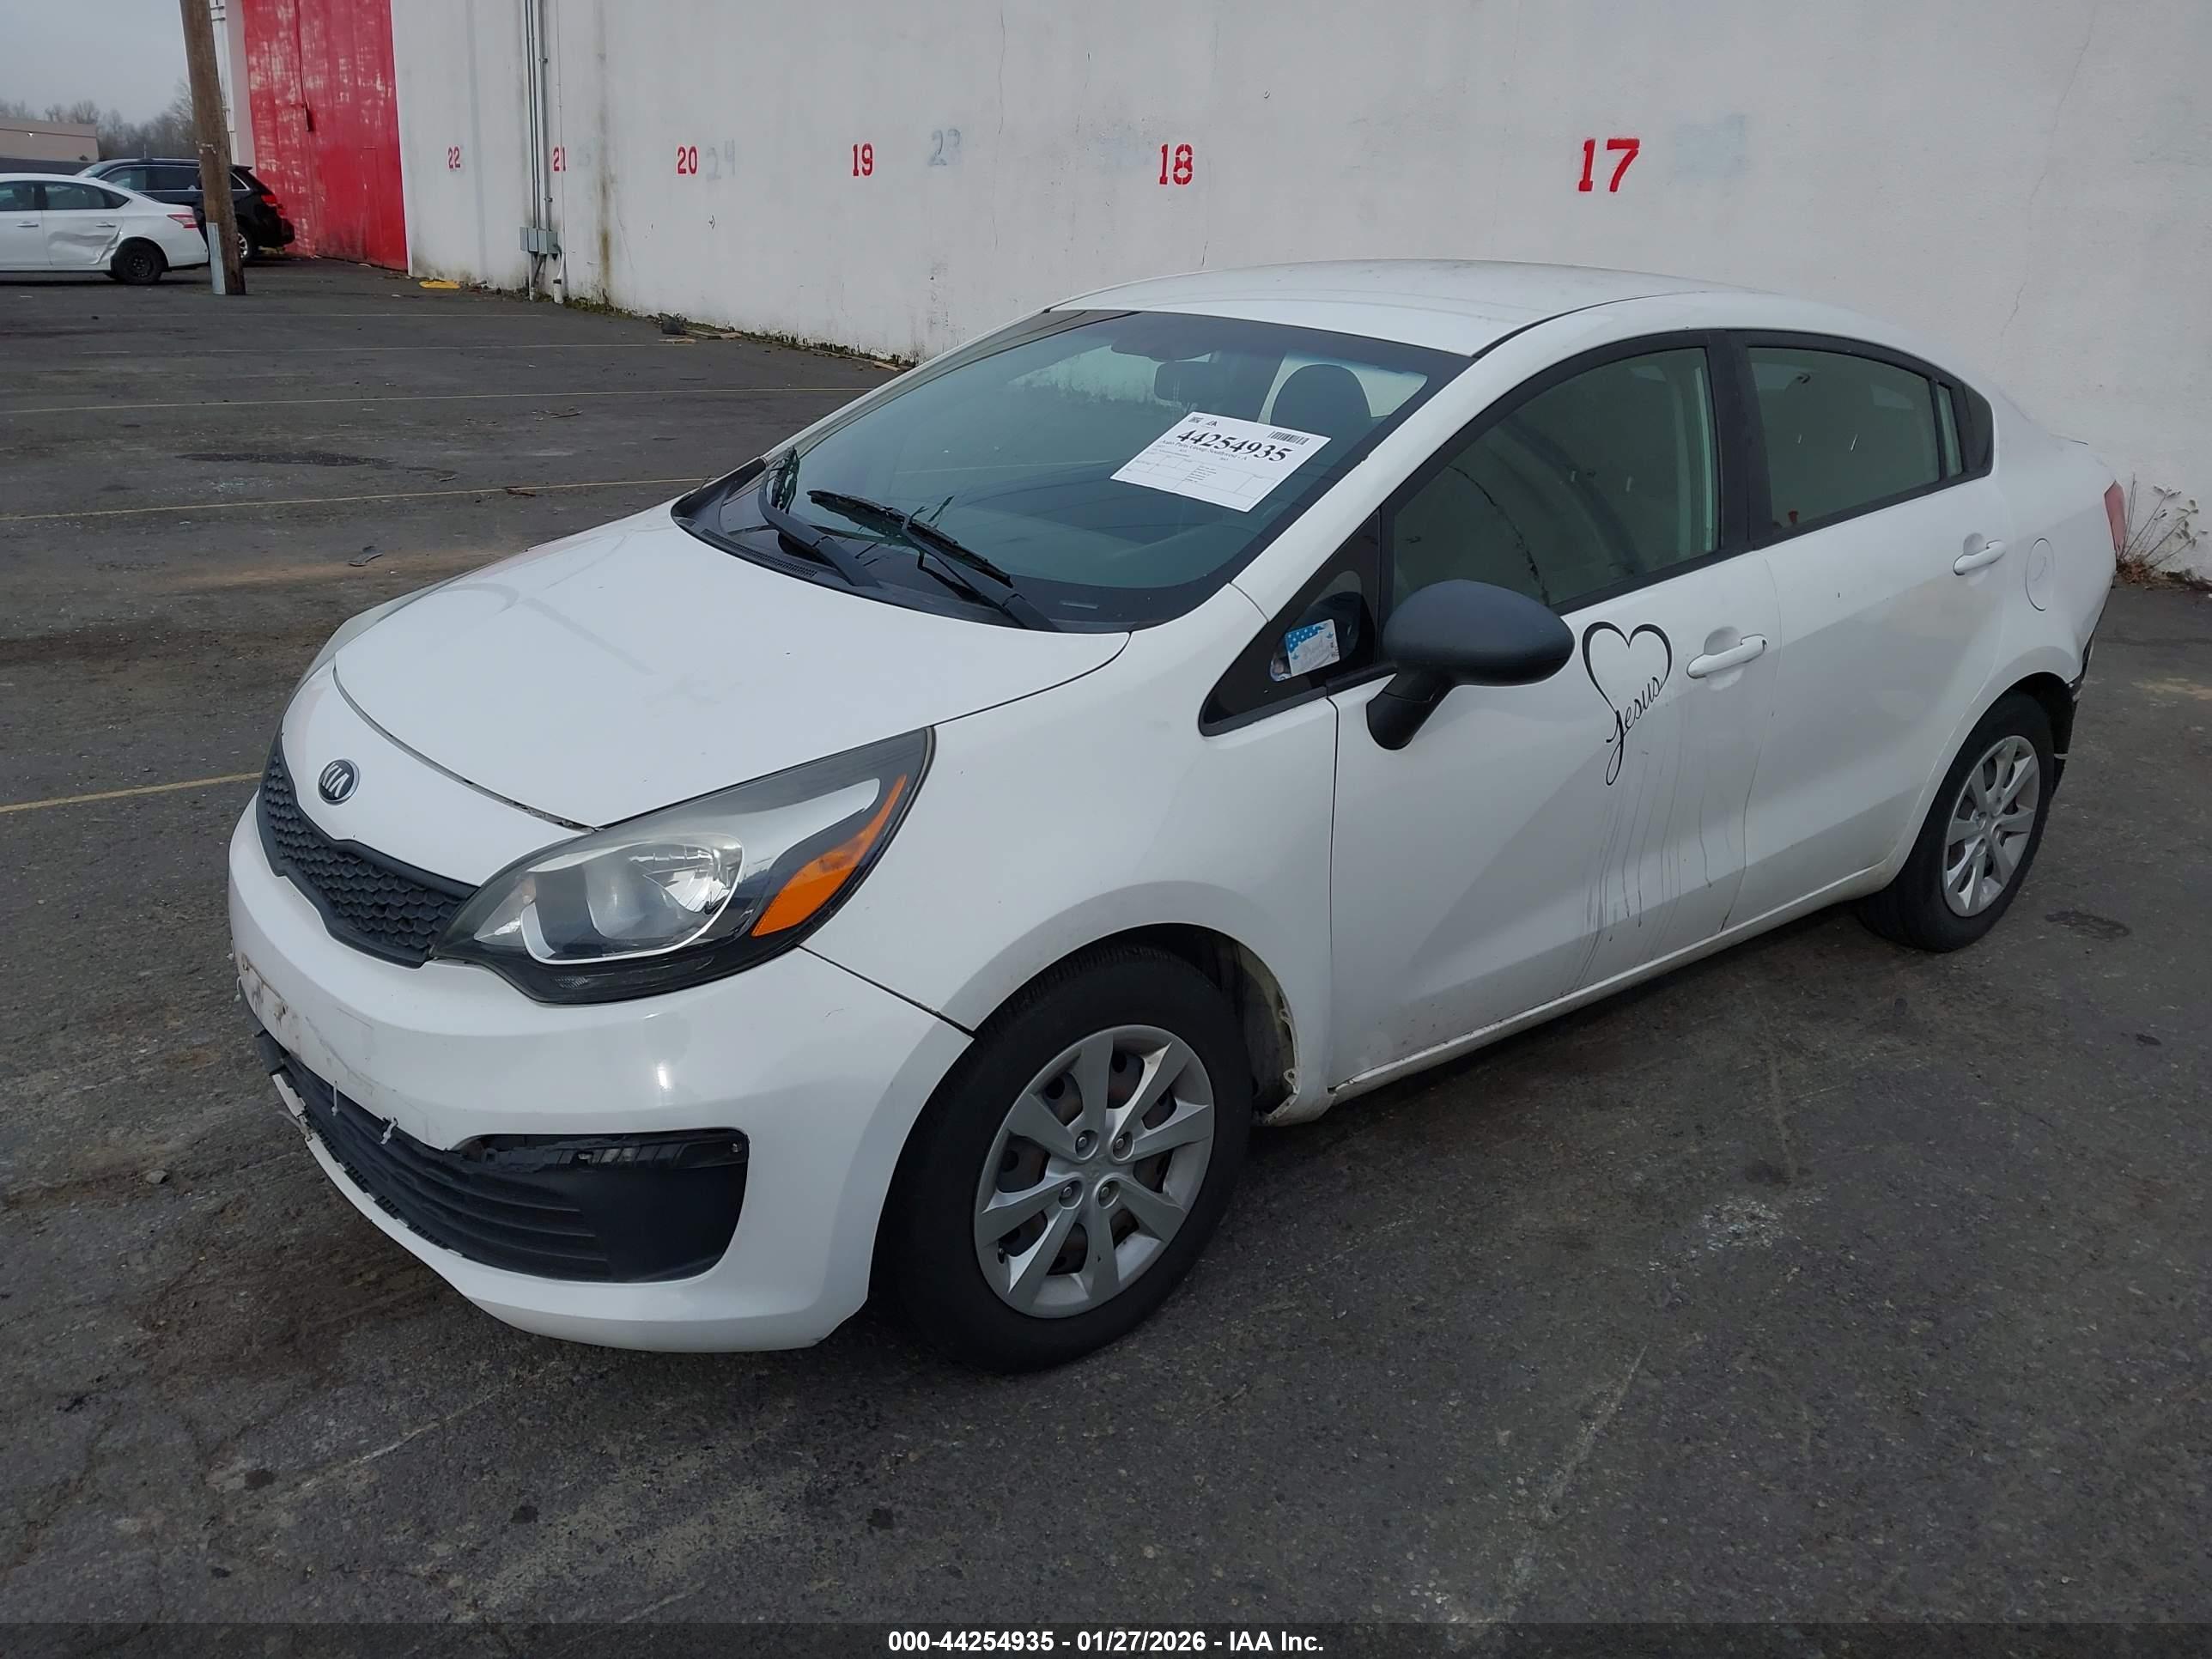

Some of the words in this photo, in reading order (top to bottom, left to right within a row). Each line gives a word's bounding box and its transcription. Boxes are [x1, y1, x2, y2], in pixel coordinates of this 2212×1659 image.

[447, 146, 461, 169] 22
[553, 146, 568, 172] 21
[677, 146, 698, 175] 20
[853, 143, 873, 178] 19
[1159, 144, 1194, 186] 18
[1577, 137, 1640, 193] 17
[1176, 429, 1295, 462] 44254935
[1606, 676, 1663, 786] Jesus
